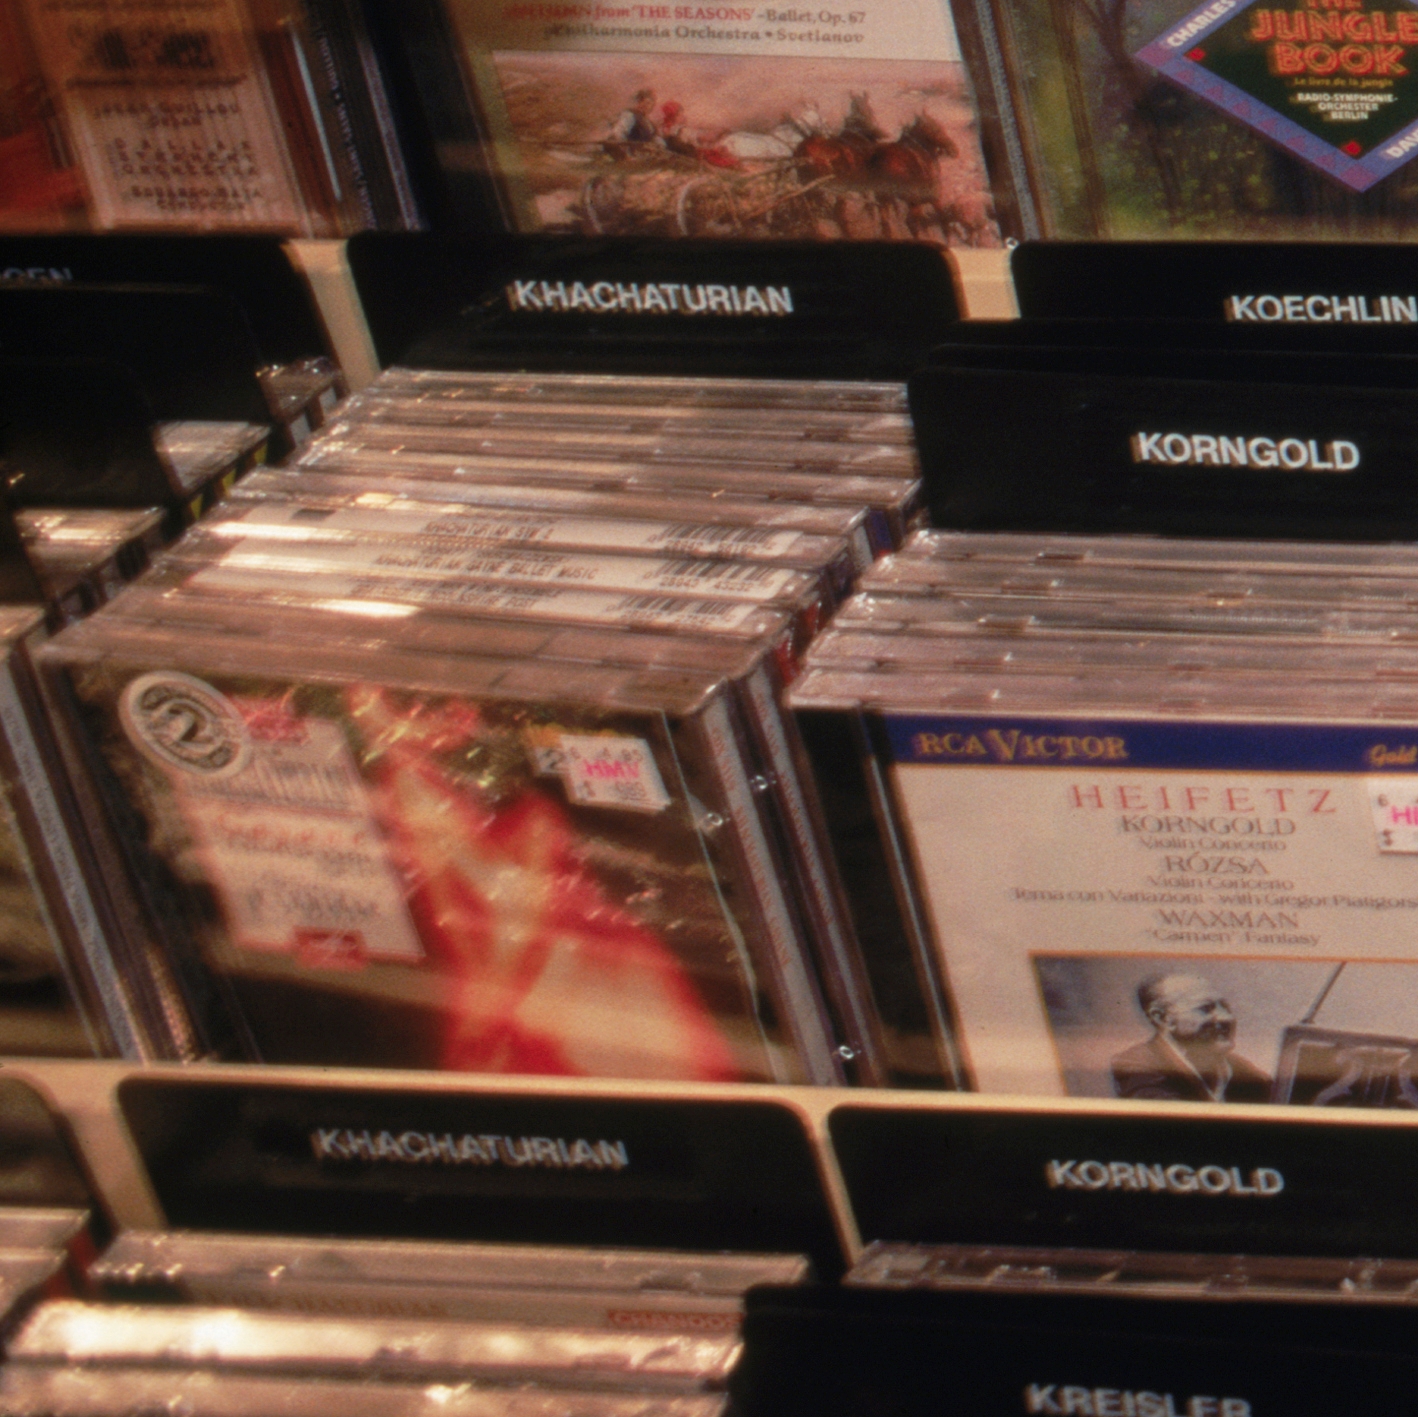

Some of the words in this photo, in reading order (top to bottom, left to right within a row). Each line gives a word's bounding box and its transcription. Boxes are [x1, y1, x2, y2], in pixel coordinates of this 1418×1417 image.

[1271, 43, 1407, 74] BOOK
[513, 280, 793, 316] KHACHATURIAN
[1232, 295, 1418, 323] KOECHLIN
[1138, 431, 1360, 470] KORNGOLD
[919, 732, 984, 754] RCA
[988, 728, 1128, 758] VICTOR
[317, 1128, 628, 1167] KHACHATURIAN
[1050, 1158, 1285, 1196] KORNGOLD
